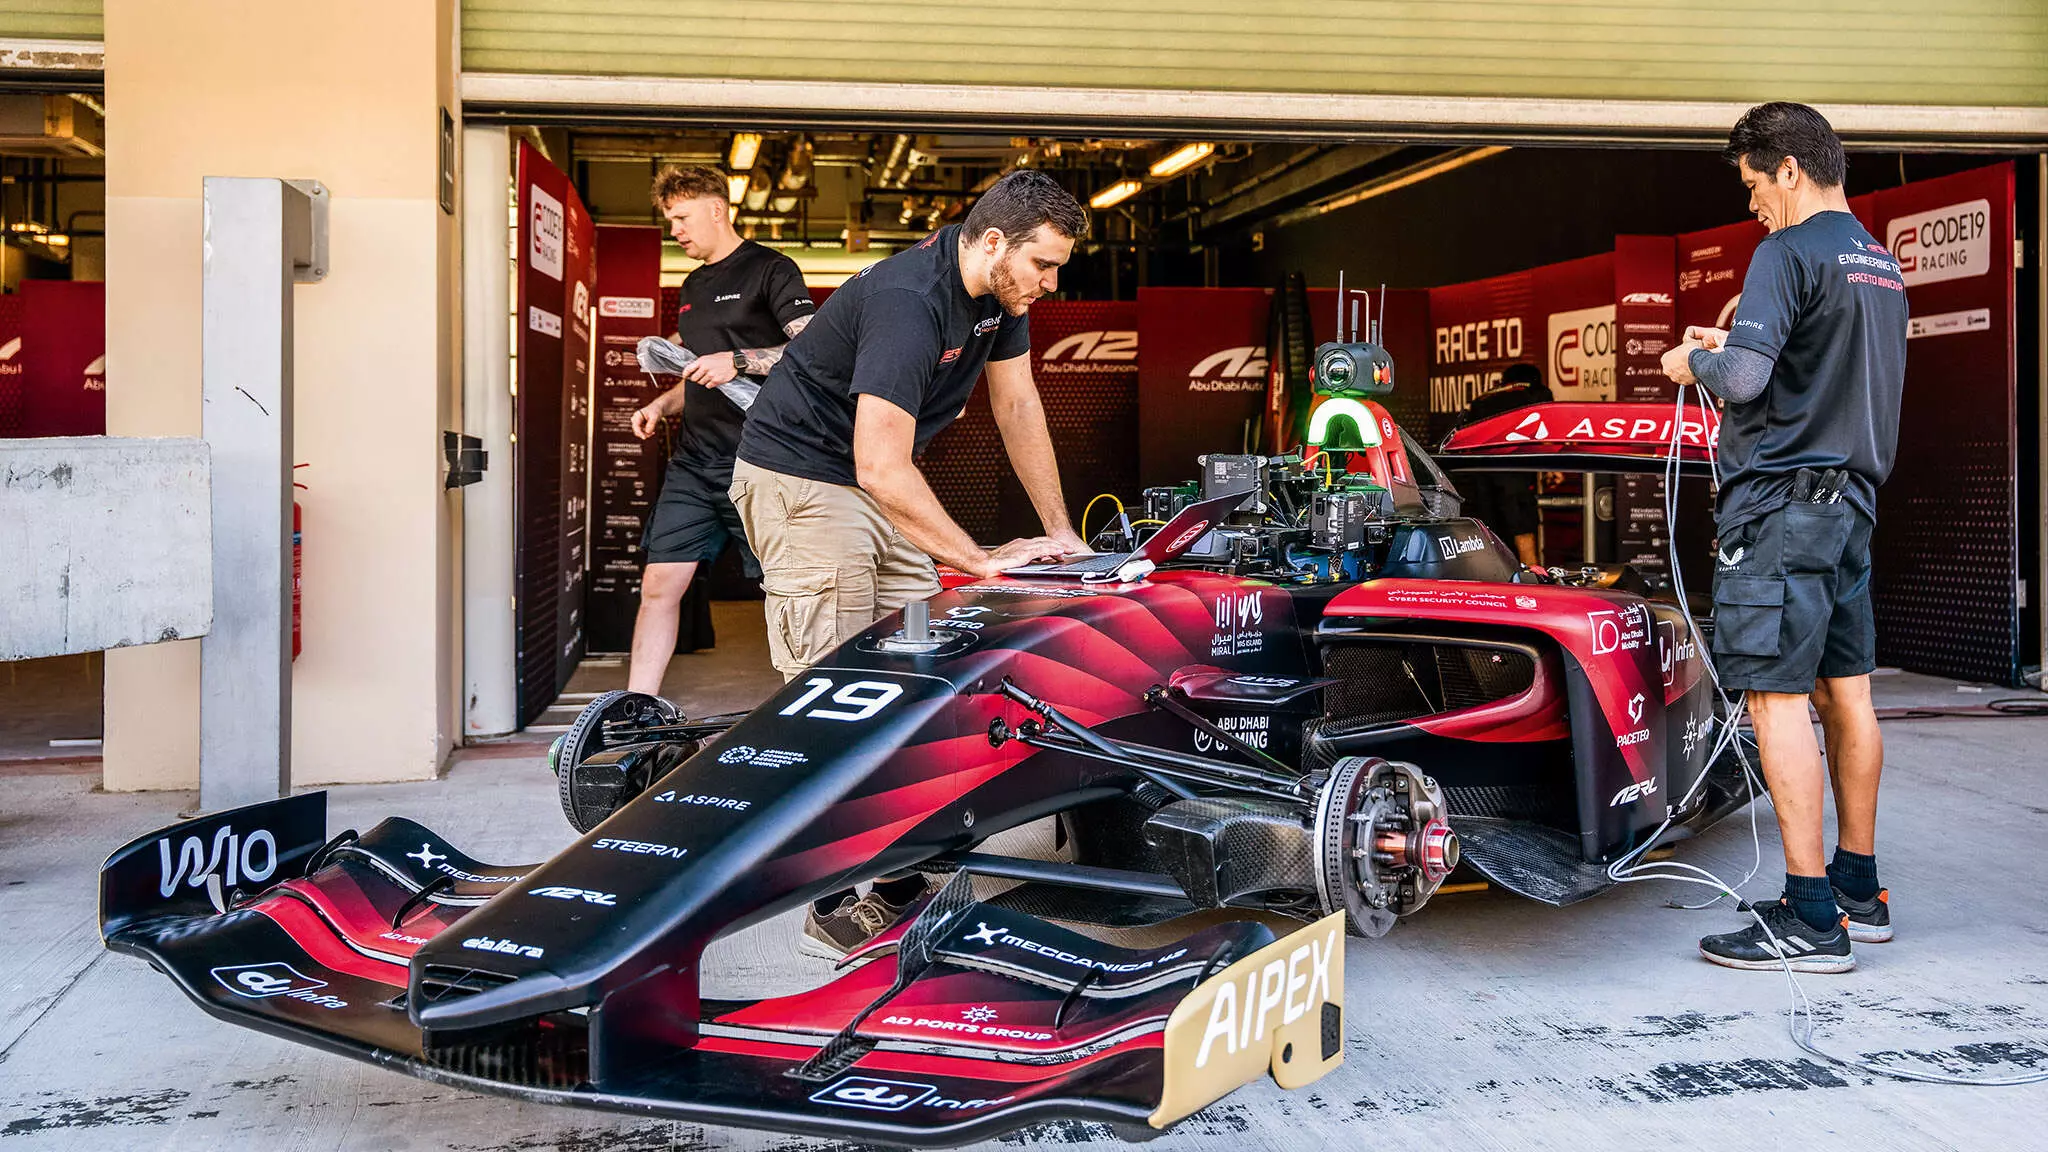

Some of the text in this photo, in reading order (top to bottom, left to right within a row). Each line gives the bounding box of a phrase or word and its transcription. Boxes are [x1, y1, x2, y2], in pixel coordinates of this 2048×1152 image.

[1920, 211, 1985, 248] CODE19
[1838, 253, 1891, 271] ENGINEERING
[1921, 250, 1967, 271] RACING
[1847, 272, 1868, 284] RACE
[1868, 274, 1877, 286] TO
[1736, 320, 1765, 330] ASPIRE
[1436, 317, 1522, 364] RACE TO
[1042, 361, 1138, 373] Abu Dhabi Autonom
[1189, 380, 1210, 391] Abu
[1211, 379, 1240, 391] Dhabi
[1454, 535, 1485, 554] Lambda
[1465, 599, 1508, 608] COUNCIL
[1211, 646, 1232, 657] MIRAL
[1675, 638, 1695, 662] Infra
[778, 678, 904, 722] 19
[1217, 716, 1269, 731] ABU DHABI
[1616, 728, 1650, 747] PACETEQ
[679, 794, 751, 811] ASPIRE
[462, 936, 545, 960] dallara
[1000, 934, 1153, 972] MECCANICA
[236, 971, 348, 1009] du Infra
[1195, 929, 1336, 1069] AIPEX
[881, 1015, 1053, 1041] AD PORTS GROUP
[835, 1086, 909, 1105] du
